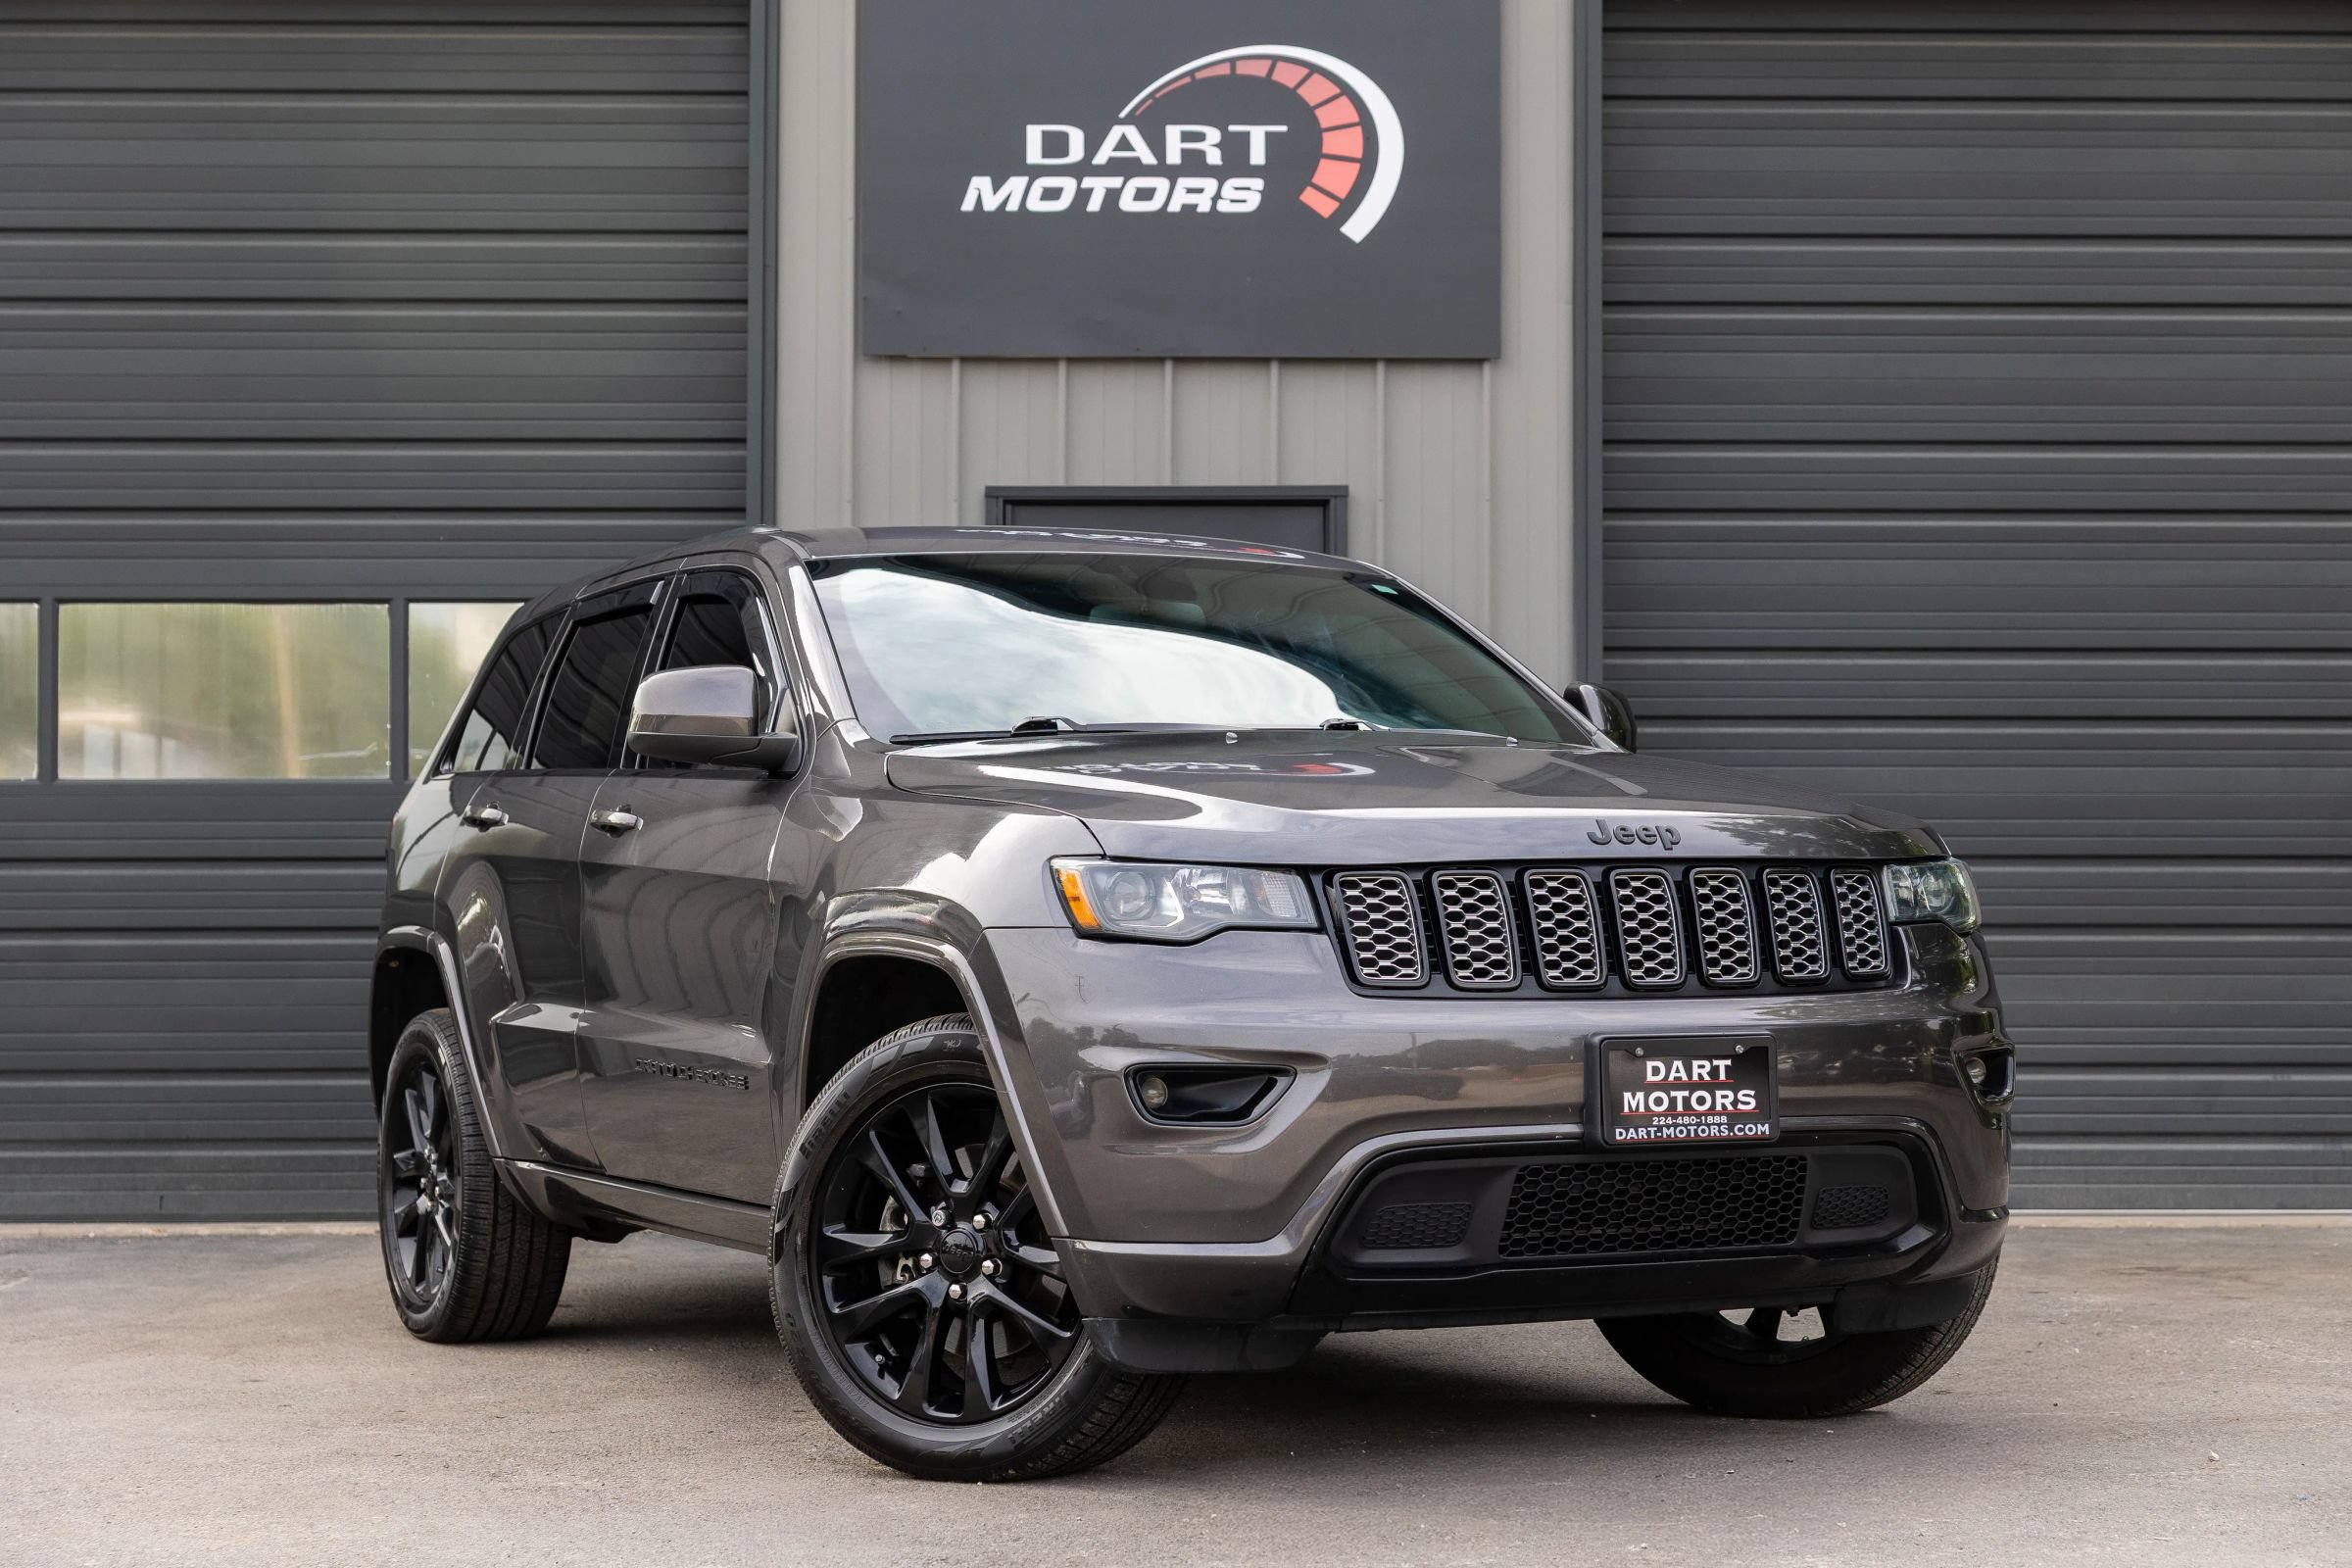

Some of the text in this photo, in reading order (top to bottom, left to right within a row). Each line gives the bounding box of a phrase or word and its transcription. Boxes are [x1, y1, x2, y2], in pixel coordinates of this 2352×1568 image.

[1026, 123, 1289, 166] DART
[959, 175, 1265, 214] MOTORS
[1587, 818, 1682, 852] Jeep
[1645, 1058, 1732, 1082] DART
[1623, 1089, 1756, 1113] MOTORS
[799, 1086, 851, 1160] PIRELLI
[1615, 1123, 1770, 1141] DART-MOTORS.COM
[1652, 1115, 1728, 1126] 224-480-1888
